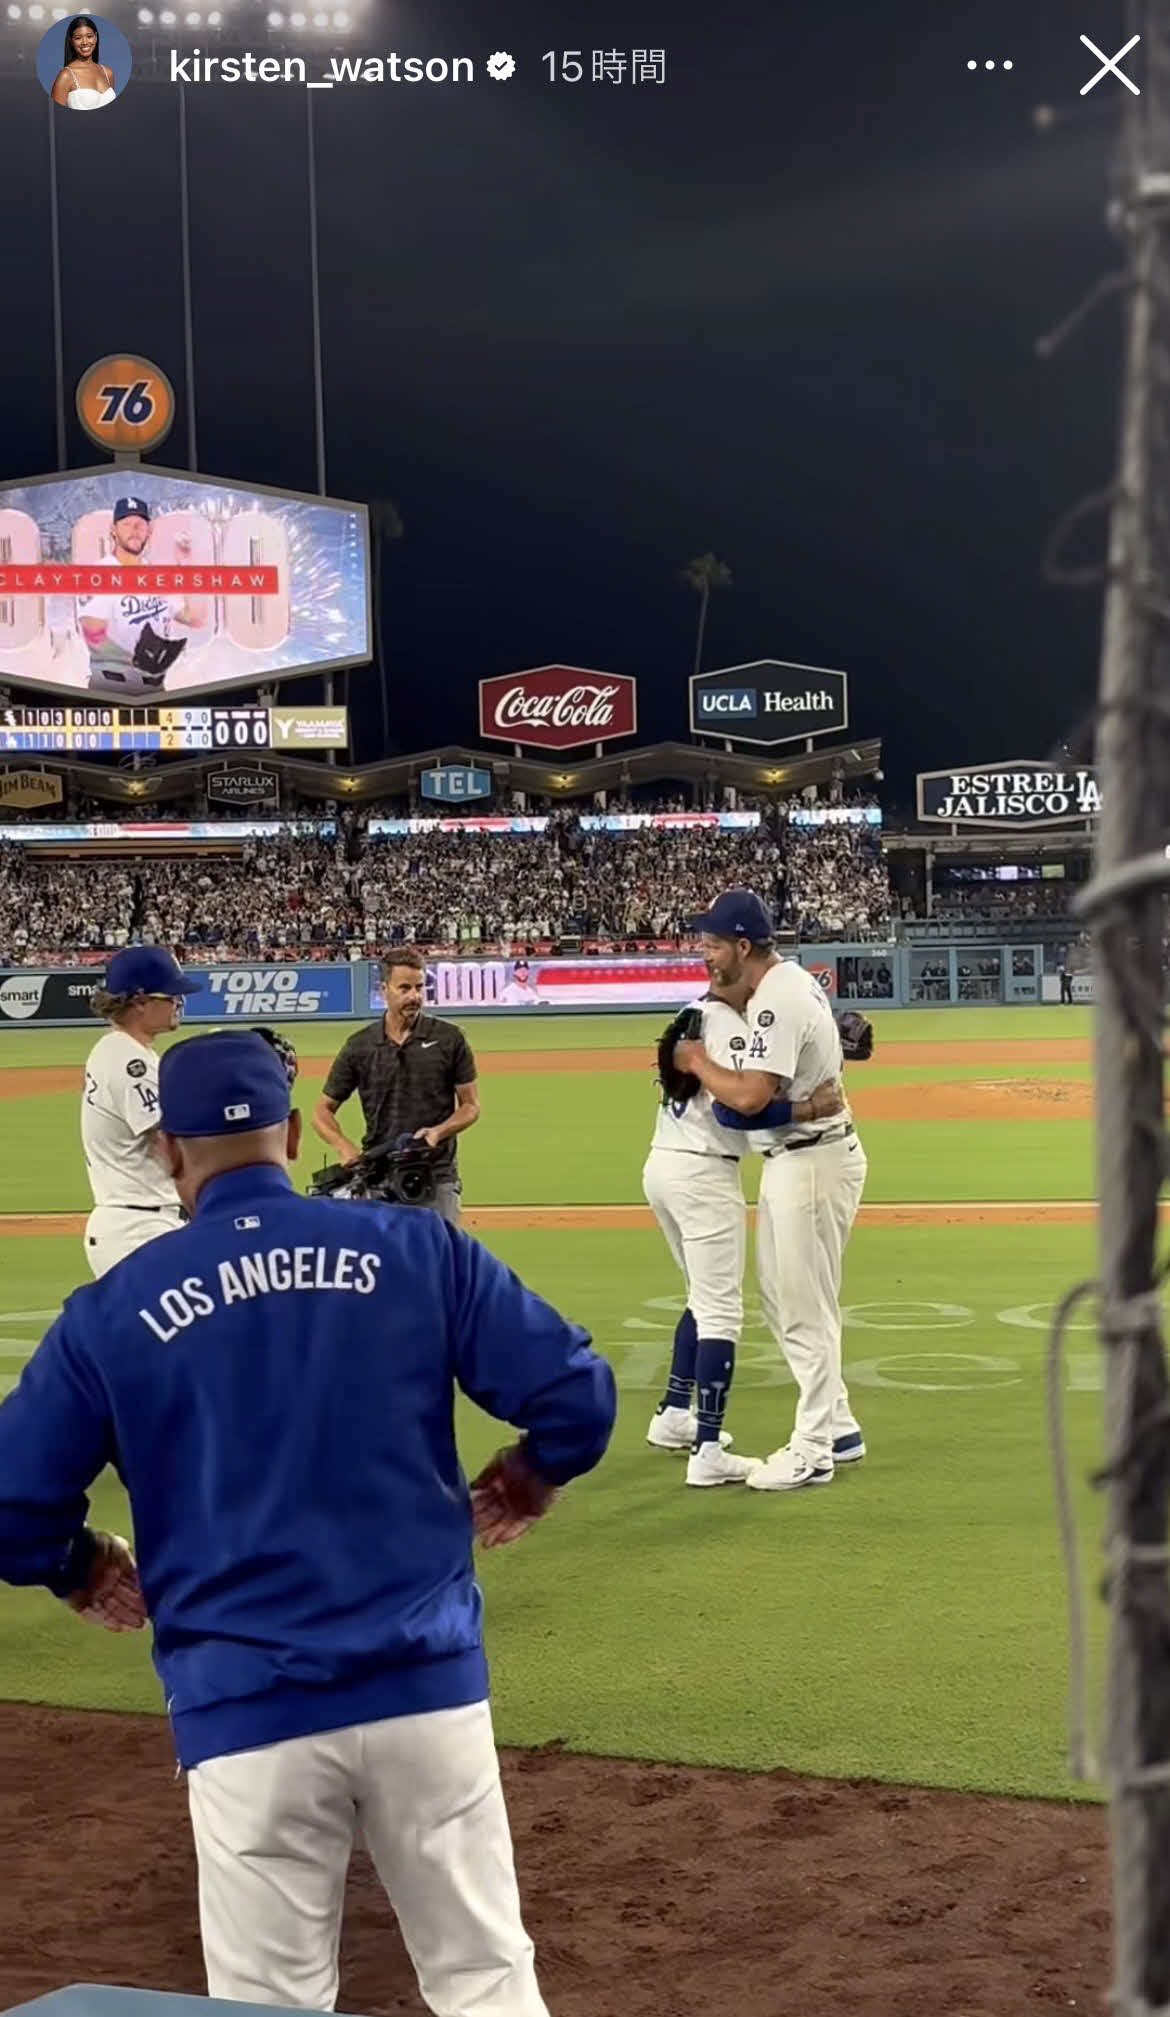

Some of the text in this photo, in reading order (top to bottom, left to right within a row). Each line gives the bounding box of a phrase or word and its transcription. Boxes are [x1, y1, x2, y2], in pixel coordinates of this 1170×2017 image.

[97, 380, 155, 425] 76
[137, 574, 266, 588] KERSHAW
[494, 685, 621, 727] Coca-Cola
[702, 691, 834, 712] UCLA Health
[0, 779, 19, 800] IM
[212, 776, 274, 788] STARLUX
[937, 793, 1069, 818] JALISCO
[67, 983, 98, 997] sma
[208, 970, 299, 993] TOYO
[0, 990, 39, 1002] smart
[224, 990, 321, 1014] TIRES
[139, 1246, 381, 1343] LOS ANGELES
